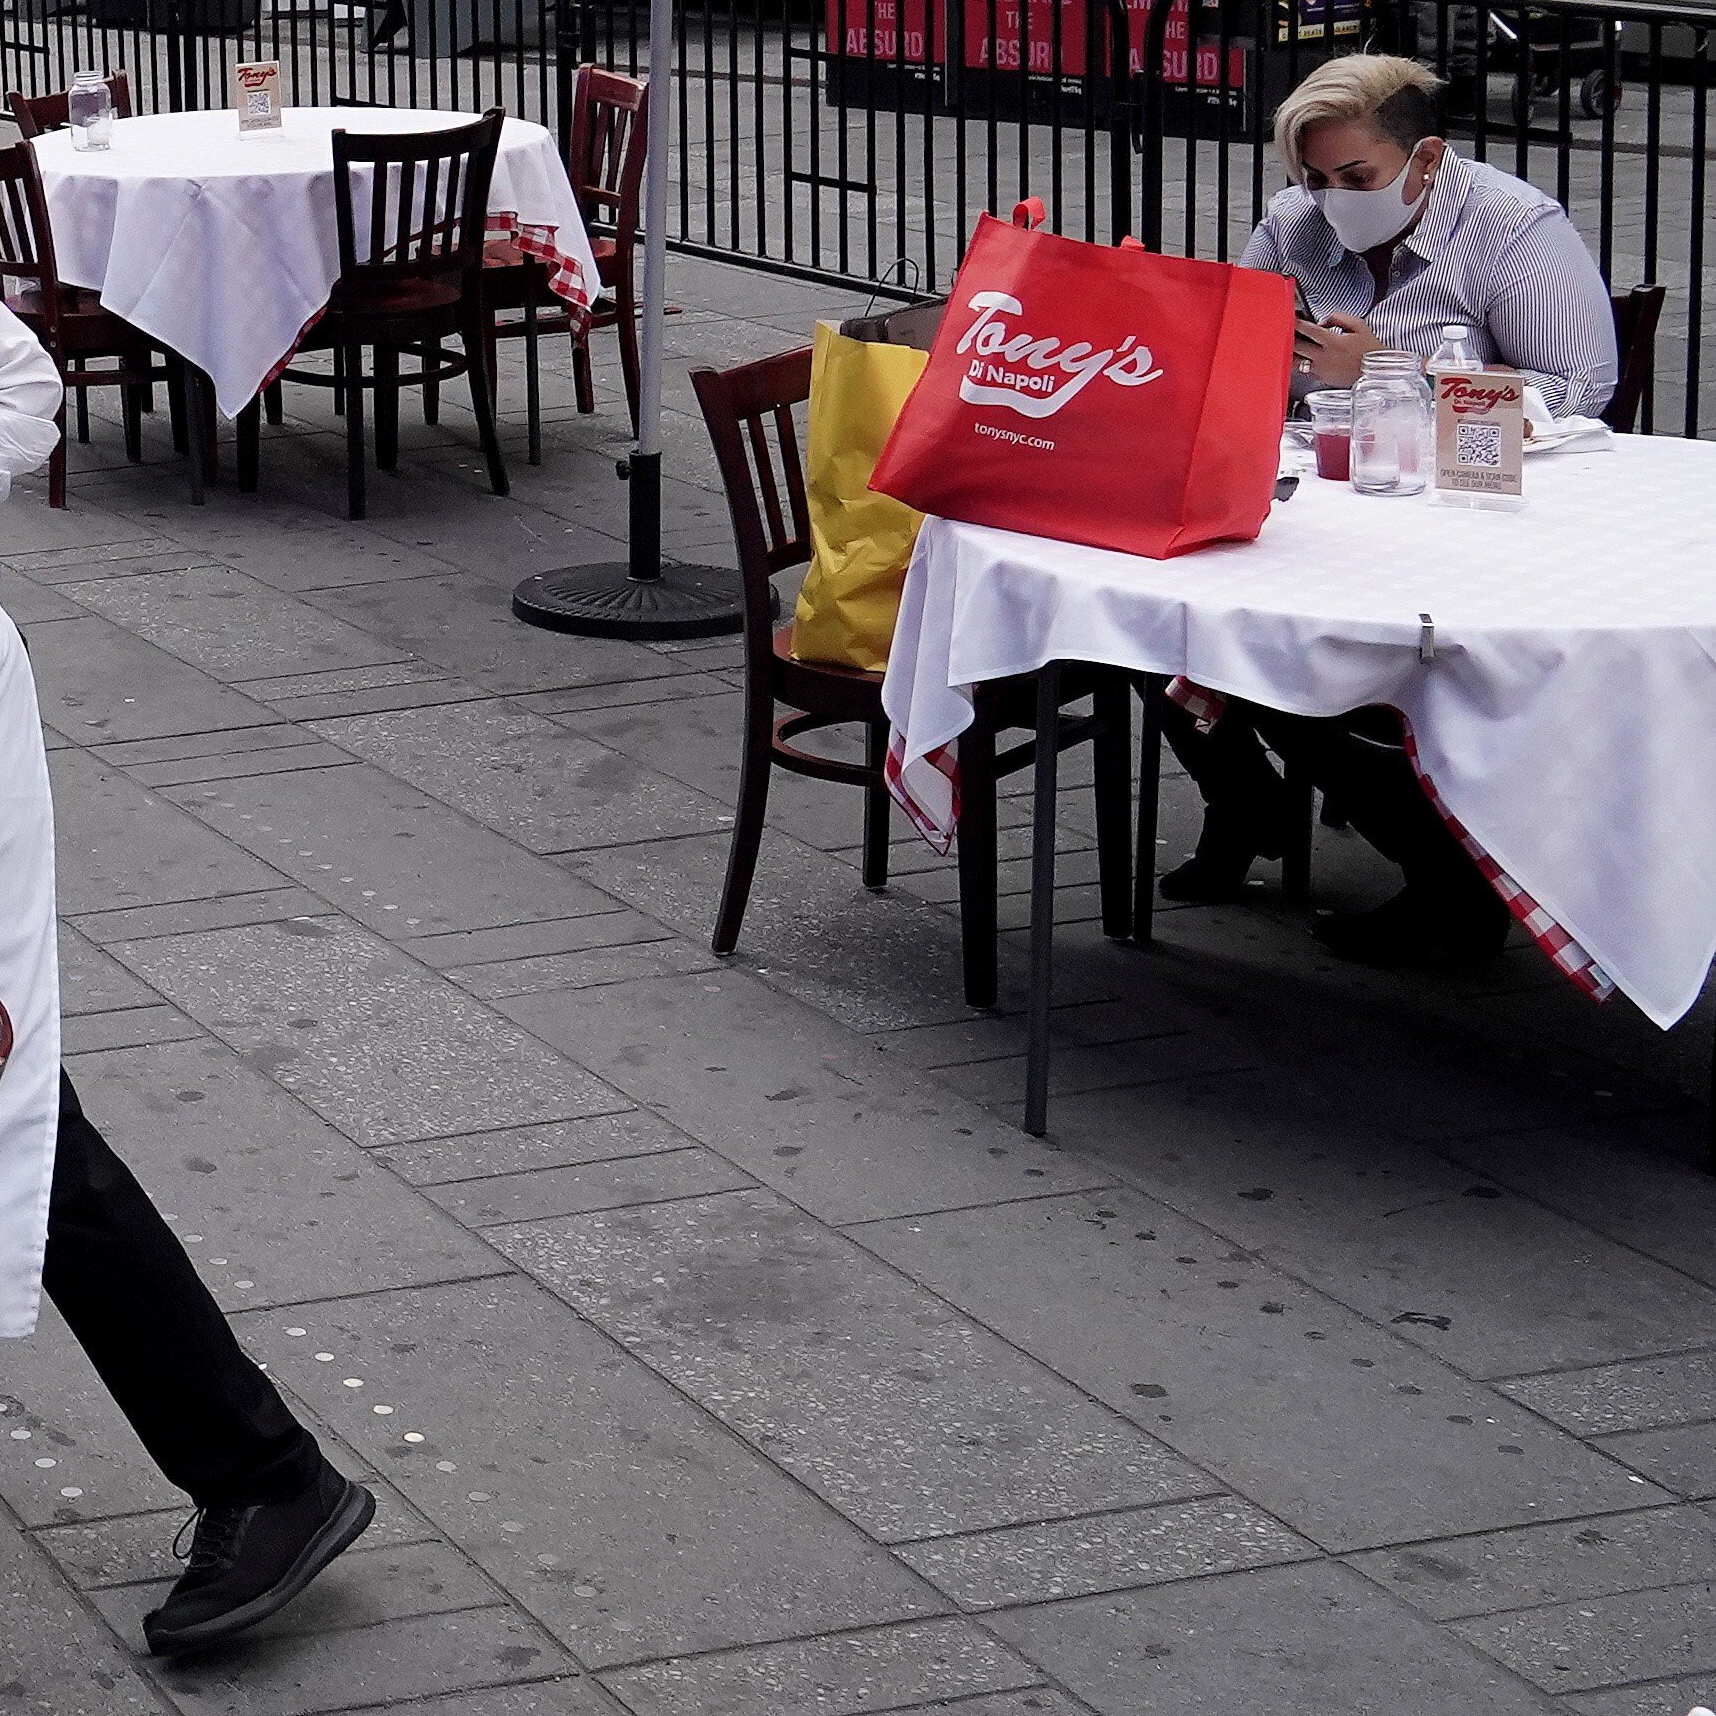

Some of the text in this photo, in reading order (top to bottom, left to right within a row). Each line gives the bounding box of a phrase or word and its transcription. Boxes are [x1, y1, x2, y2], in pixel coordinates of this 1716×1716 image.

[956, 291, 1164, 418] Tony's
[969, 359, 1056, 393] Di Napoli
[1440, 377, 1520, 415] Tony's
[974, 422, 1056, 451] tonysnyc.com
